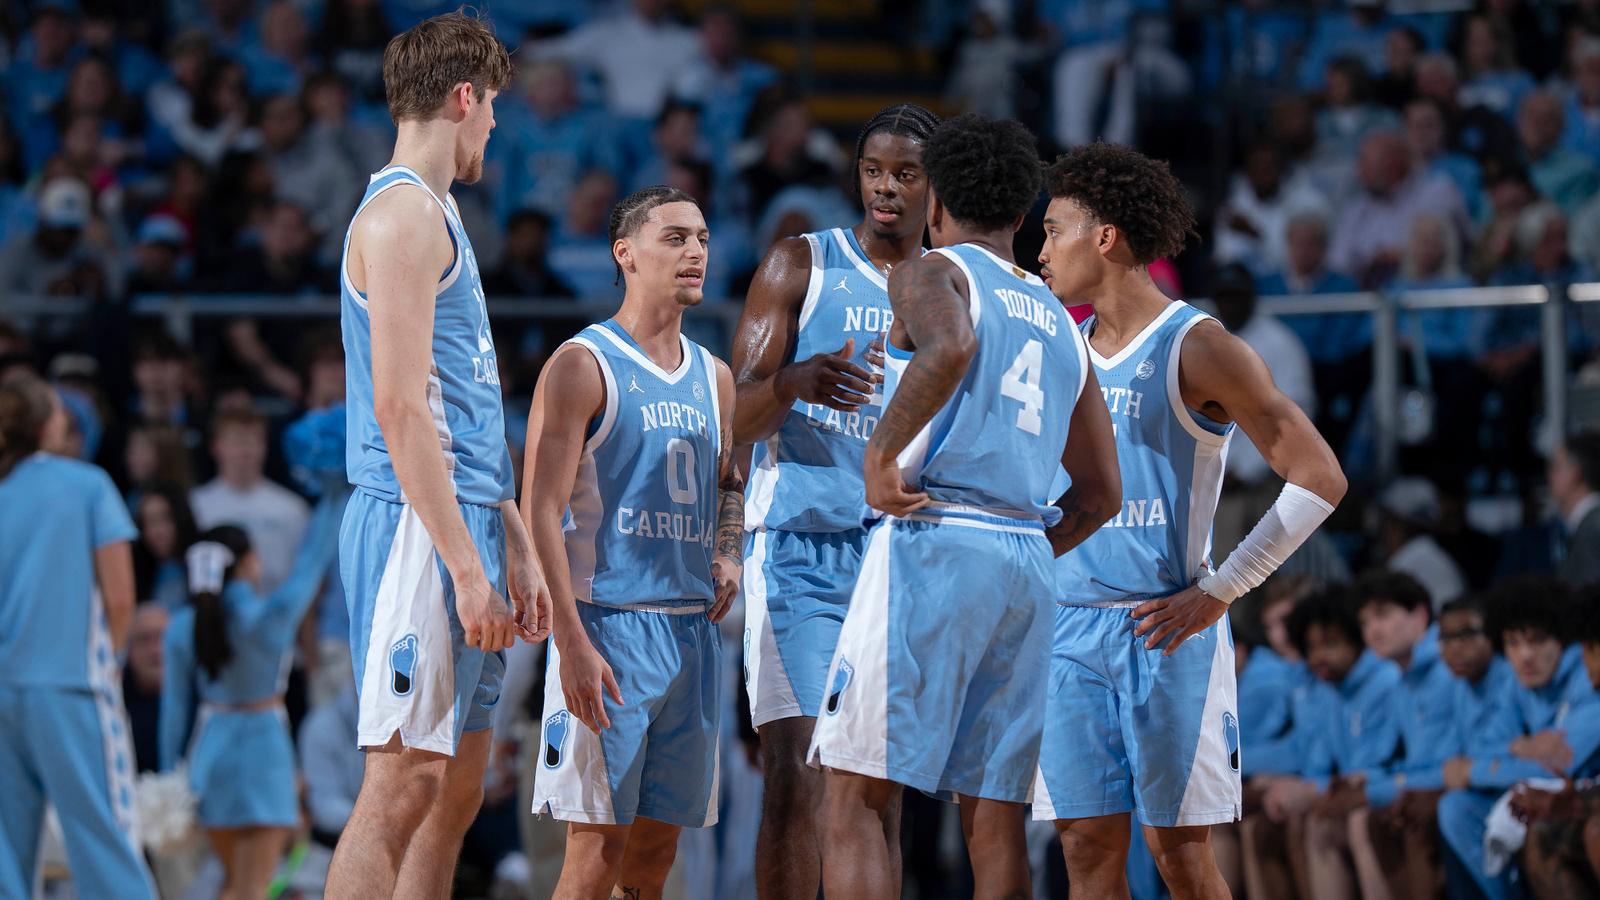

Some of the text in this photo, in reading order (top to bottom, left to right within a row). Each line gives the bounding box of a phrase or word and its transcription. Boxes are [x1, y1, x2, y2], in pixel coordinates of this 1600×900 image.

[994, 288, 1057, 337] YOUNG
[1001, 338, 1044, 437] 4
[640, 401, 709, 441] NORTH
[666, 438, 698, 505] 0
